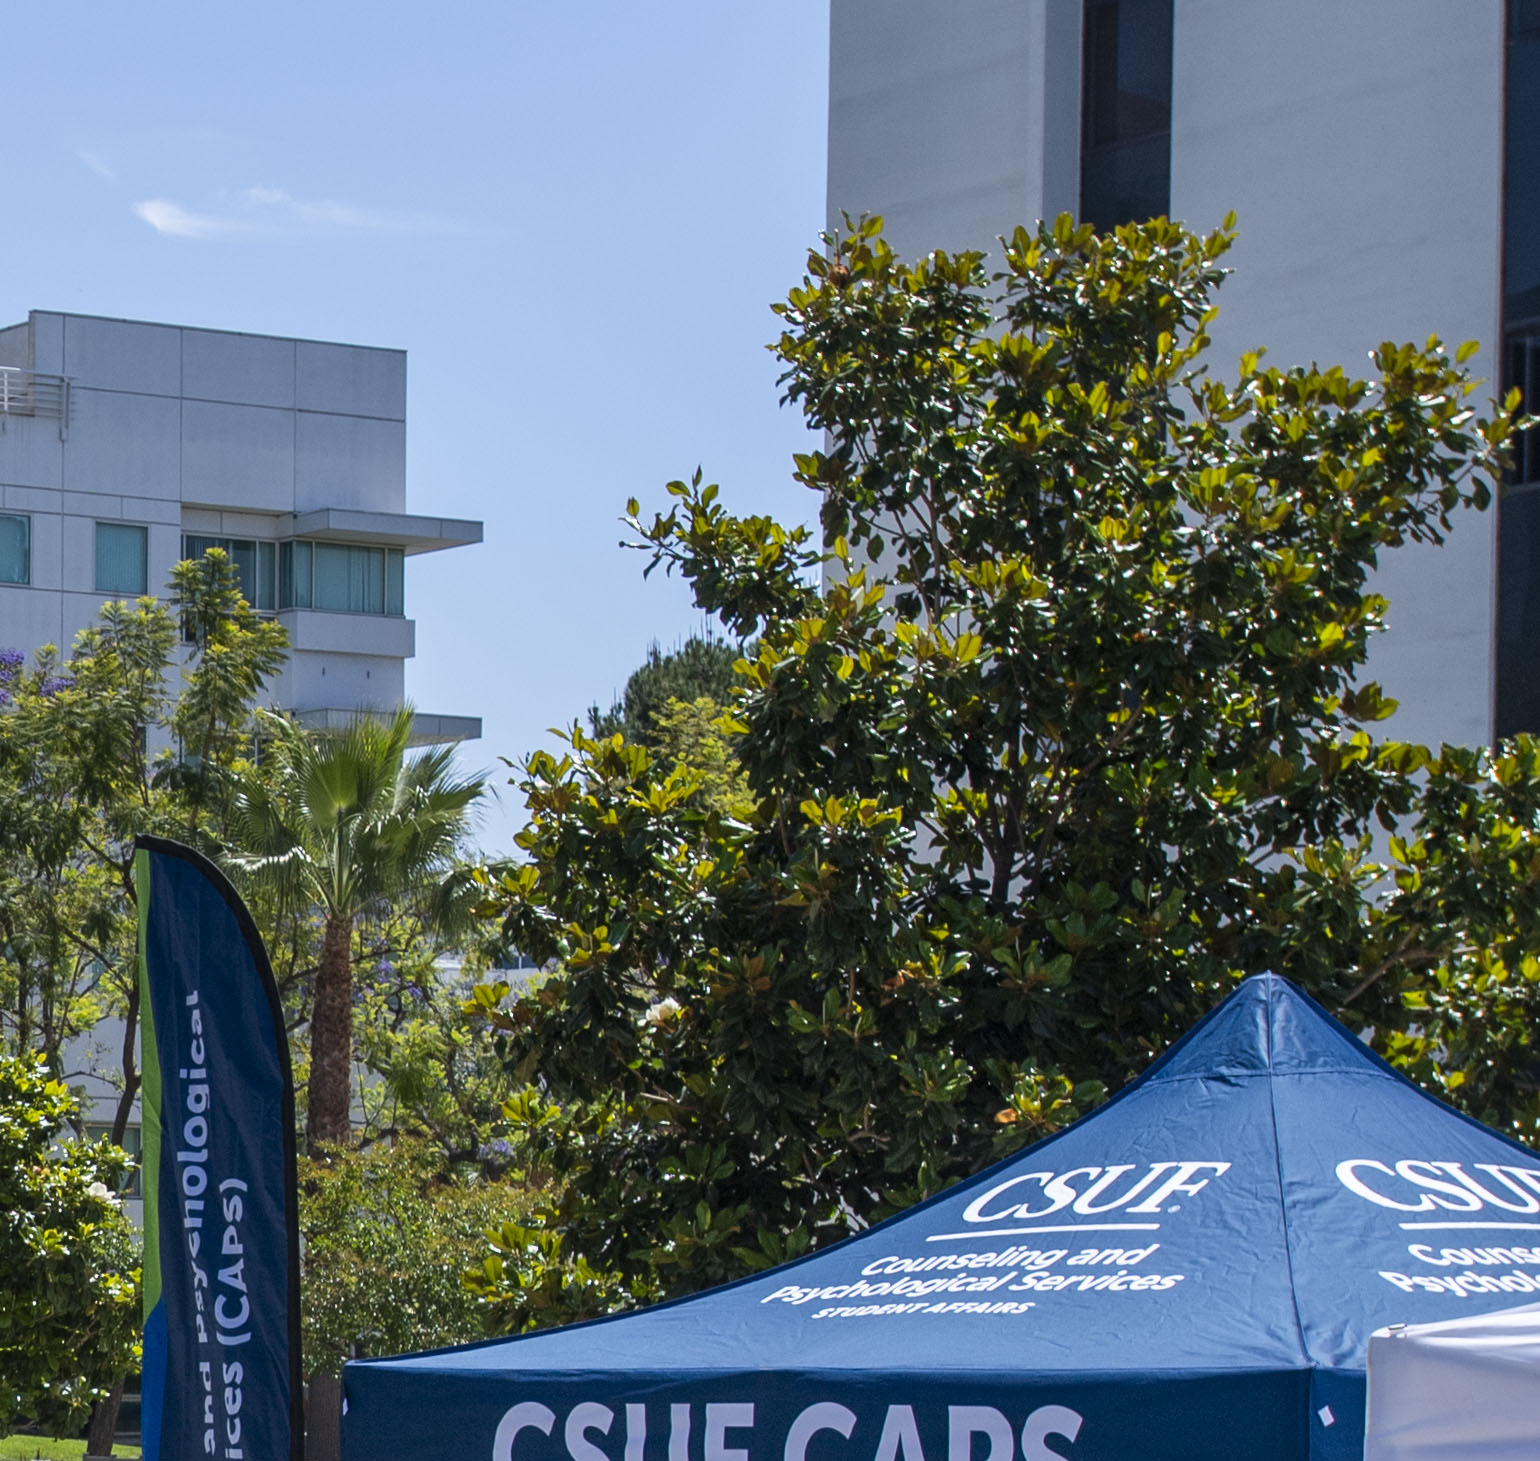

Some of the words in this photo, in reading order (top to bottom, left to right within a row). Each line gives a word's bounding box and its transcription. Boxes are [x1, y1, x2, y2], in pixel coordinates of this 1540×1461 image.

[962, 1161, 1232, 1223] CSUF
[1335, 1159, 1540, 1214] CSU
[214, 1177, 252, 1346] (CAPS)
[860, 1244, 1068, 1276] Counseling
[1067, 1243, 1161, 1266] and
[1408, 1243, 1540, 1266] Couns
[760, 1271, 1011, 1304] Psychological
[1008, 1270, 1186, 1292] Services
[1378, 1270, 1540, 1297] Psychol
[811, 1302, 927, 1319] STUDENT
[921, 1301, 1036, 1314] AFFAIRS
[198, 1361, 218, 1456] and
